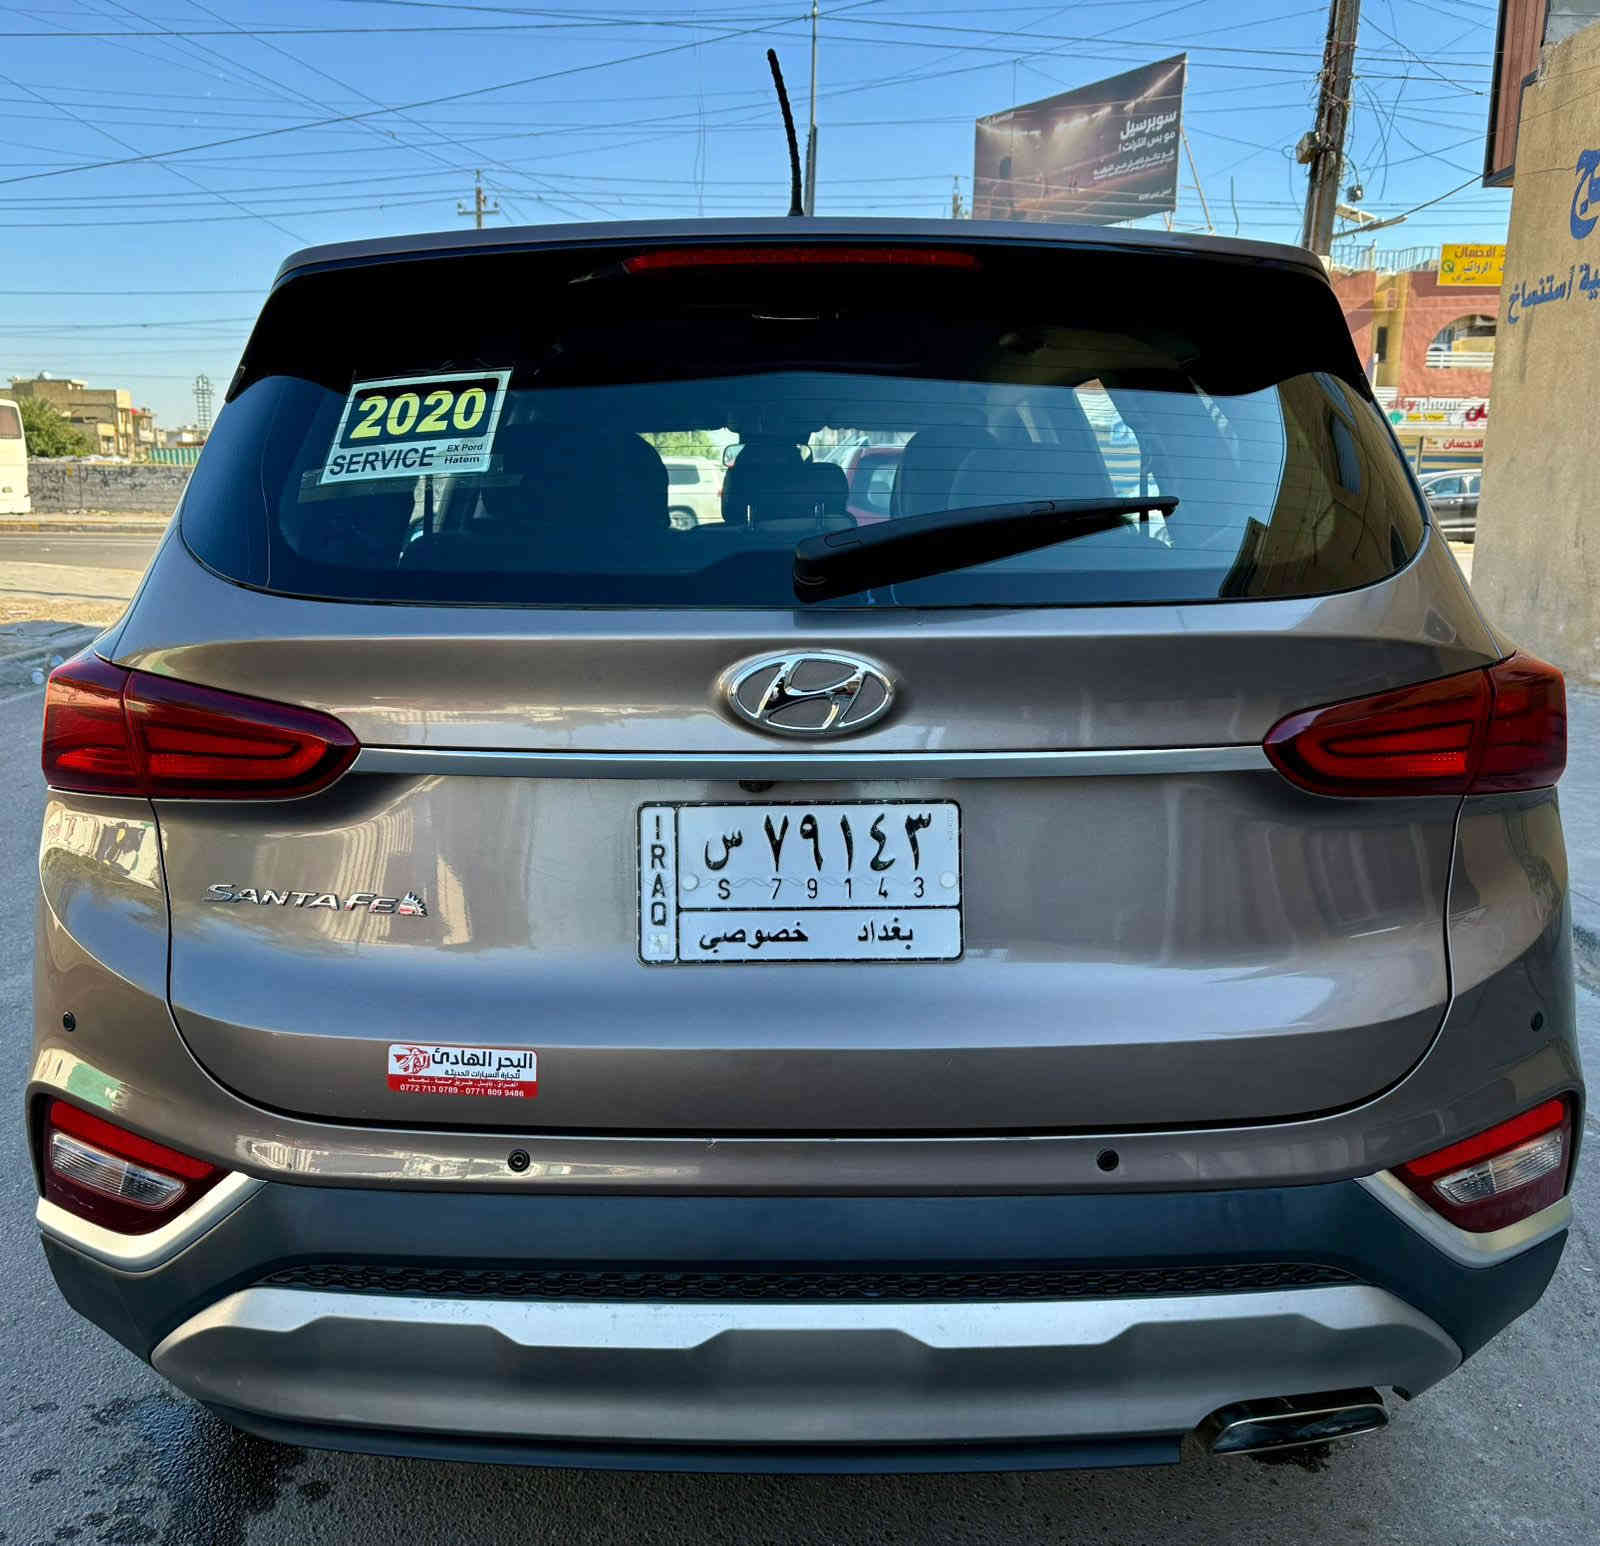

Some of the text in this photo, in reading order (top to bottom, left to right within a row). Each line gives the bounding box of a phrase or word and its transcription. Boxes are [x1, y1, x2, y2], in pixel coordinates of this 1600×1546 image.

[350, 387, 487, 439] 2020
[330, 446, 437, 476] SERVICE
[650, 815, 667, 927] IRAQ
[204, 884, 340, 911] SANTA
[699, 917, 914, 953] بغداد خصوصي
[432, 1047, 533, 1072] البحر الهادئ
